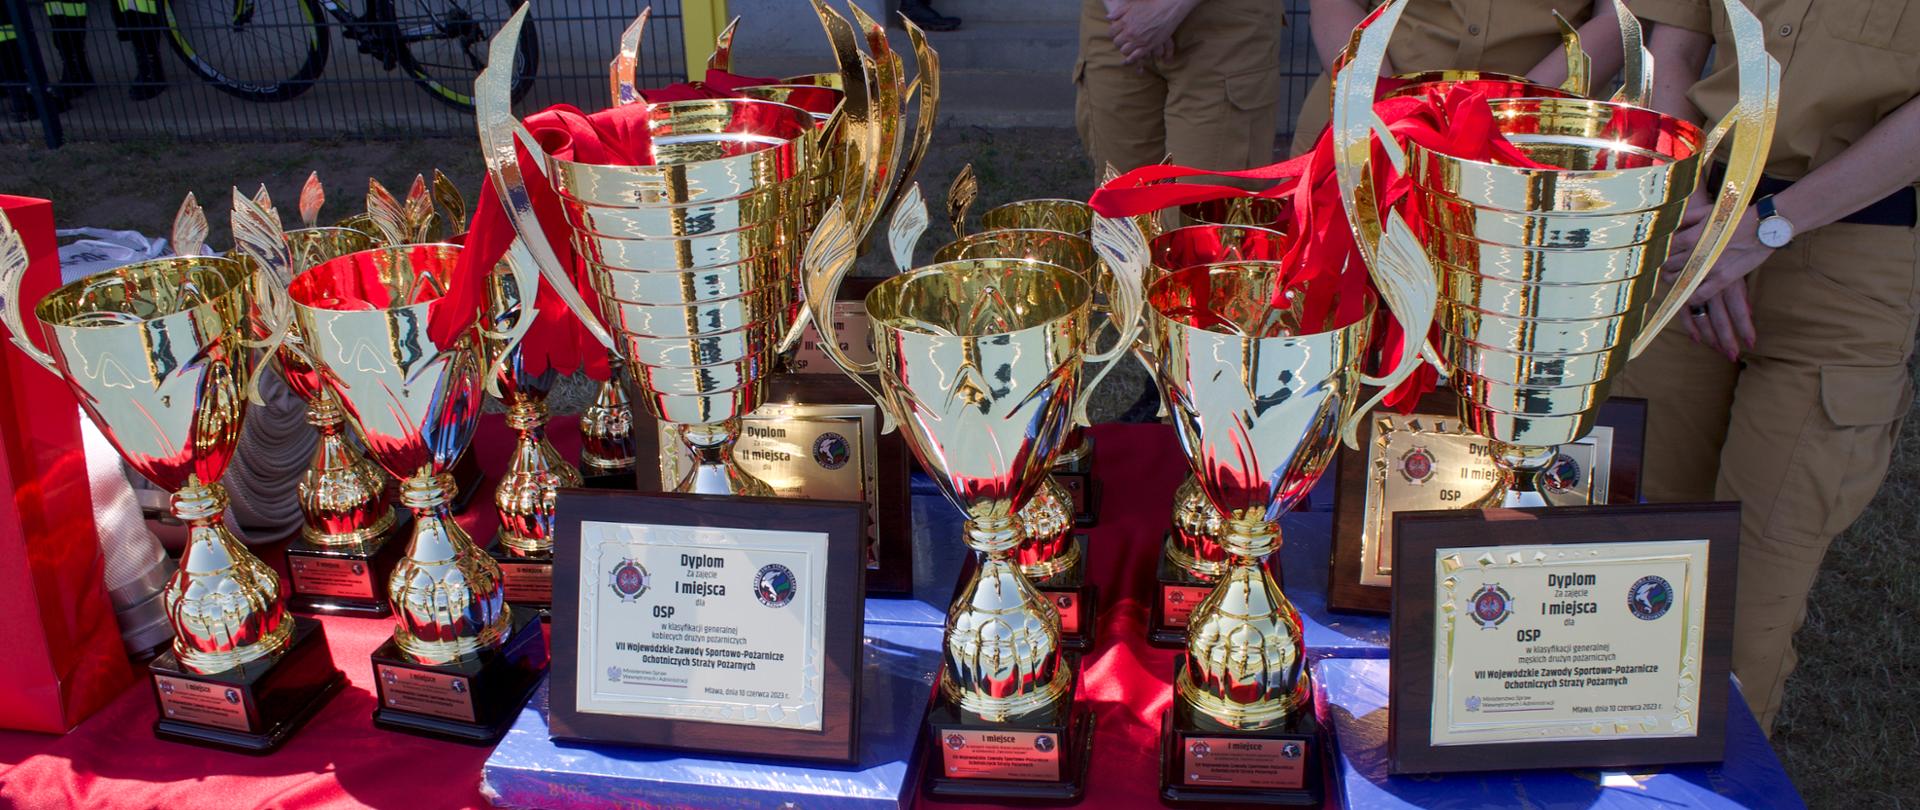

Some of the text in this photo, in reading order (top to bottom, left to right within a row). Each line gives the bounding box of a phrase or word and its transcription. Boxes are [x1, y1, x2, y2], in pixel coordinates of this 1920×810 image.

[748, 426, 786, 439] Dyplom
[752, 450, 791, 462] miejsca
[1461, 467, 1468, 479] II
[1440, 489, 1461, 501] OSP
[681, 554, 724, 569] Dyplom
[1548, 573, 1596, 589] Dyplom
[675, 581, 725, 598] I miejsca
[695, 599, 705, 607] dla
[1542, 601, 1597, 616] I miejsca
[653, 605, 675, 618] OSP
[1564, 618, 1575, 626] dla
[668, 623, 702, 634] klasyfikacji
[704, 626, 738, 636] generalnej
[1517, 629, 1541, 642] OSP
[652, 632, 683, 642] kobiecych
[616, 641, 625, 651] VII
[675, 645, 704, 656] Zawody
[1533, 644, 1571, 655] klasyfikacji
[1573, 643, 1610, 653] generalnej
[642, 654, 690, 667] Ochotniczych
[1475, 671, 1486, 679] VII
[1541, 667, 1572, 678] Zawody
[1504, 679, 1558, 690] Ochotniczych
[987, 735, 1016, 743] miejsce
[1233, 743, 1263, 751] miejsce
